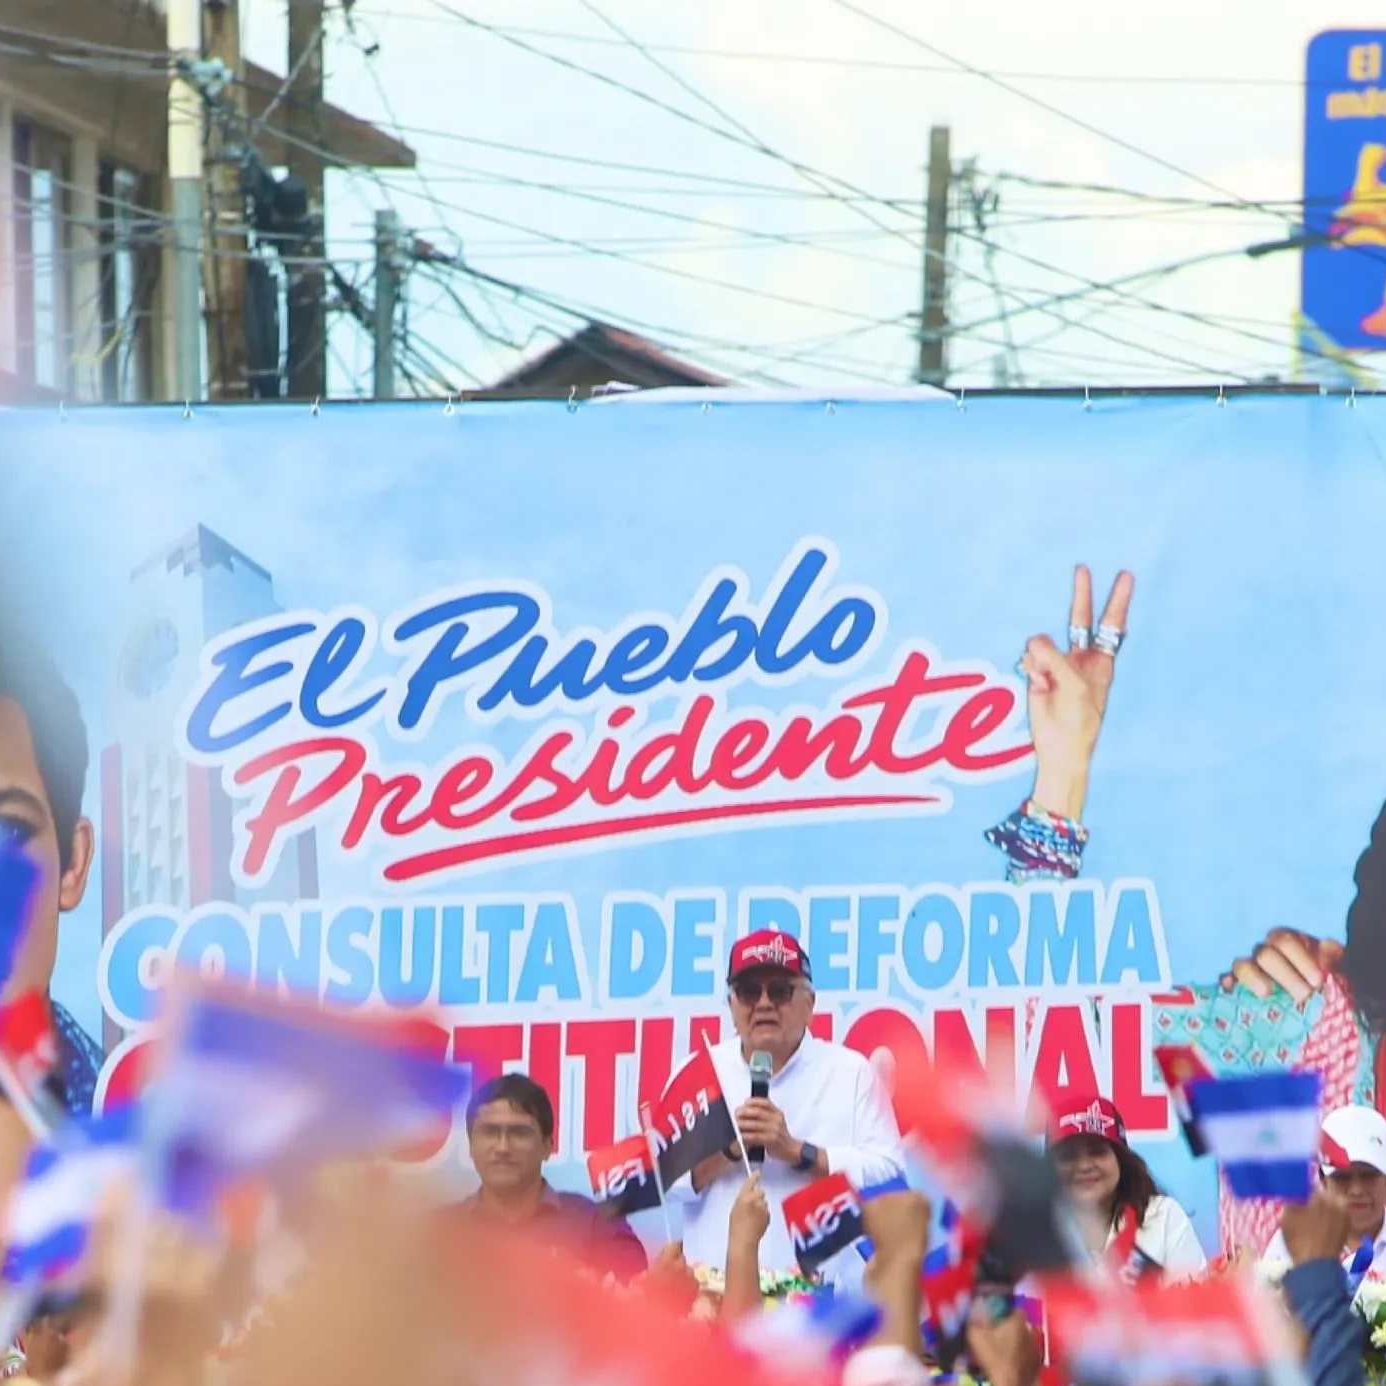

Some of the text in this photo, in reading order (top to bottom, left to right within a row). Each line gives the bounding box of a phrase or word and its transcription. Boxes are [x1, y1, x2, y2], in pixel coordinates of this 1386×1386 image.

[1348, 42, 1382, 82] El
[186, 548, 876, 753] El Pueblo
[234, 650, 1036, 875] Presidente
[107, 902, 582, 1021] CONSULTA
[614, 898, 715, 999] DE
